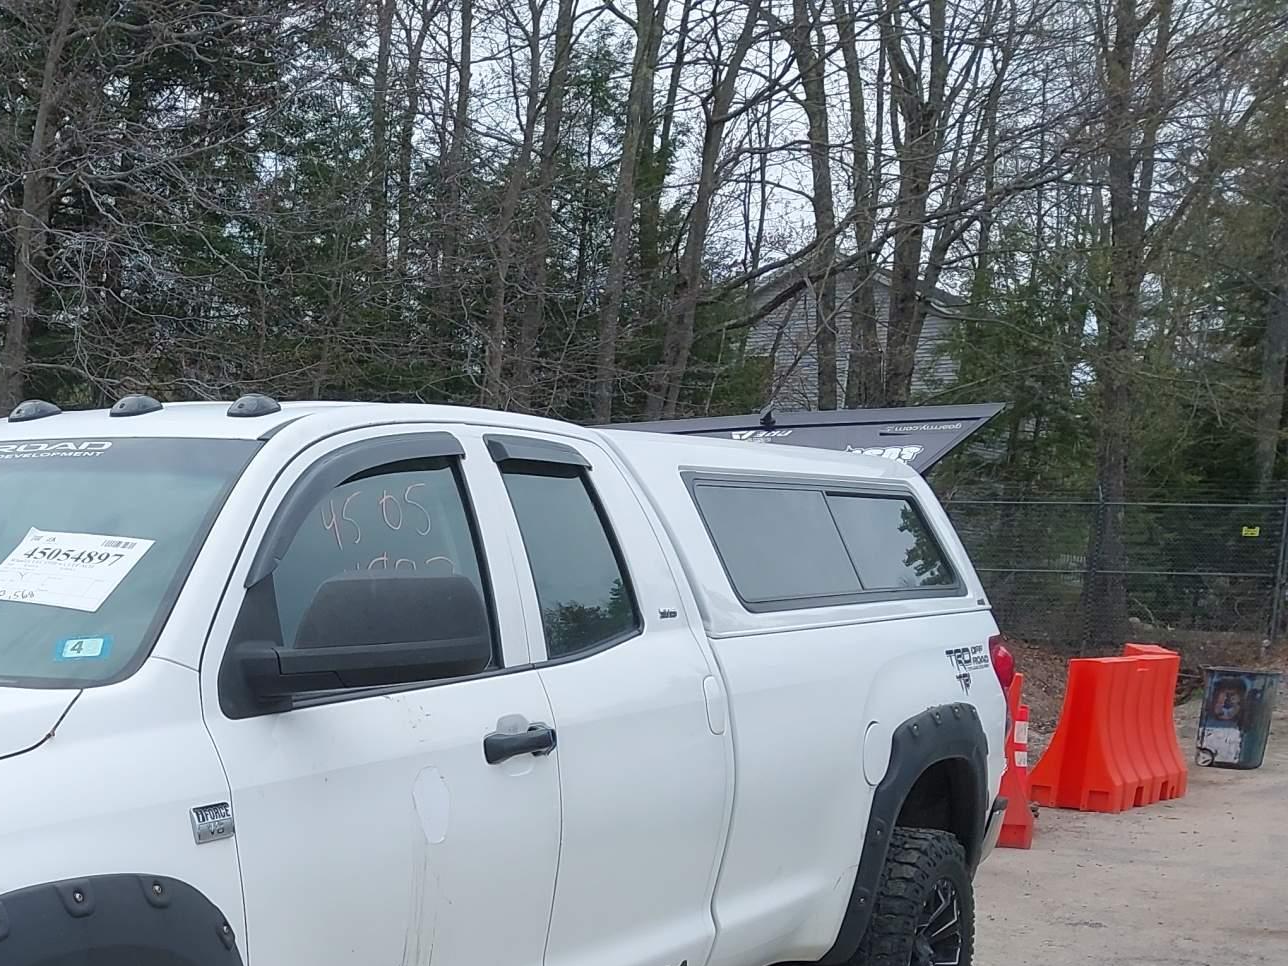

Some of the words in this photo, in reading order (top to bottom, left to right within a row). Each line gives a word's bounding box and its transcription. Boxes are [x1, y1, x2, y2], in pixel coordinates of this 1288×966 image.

[24, 546, 124, 567] 45054897
[70, 640, 84, 654] 4
[945, 647, 972, 671] TRD
